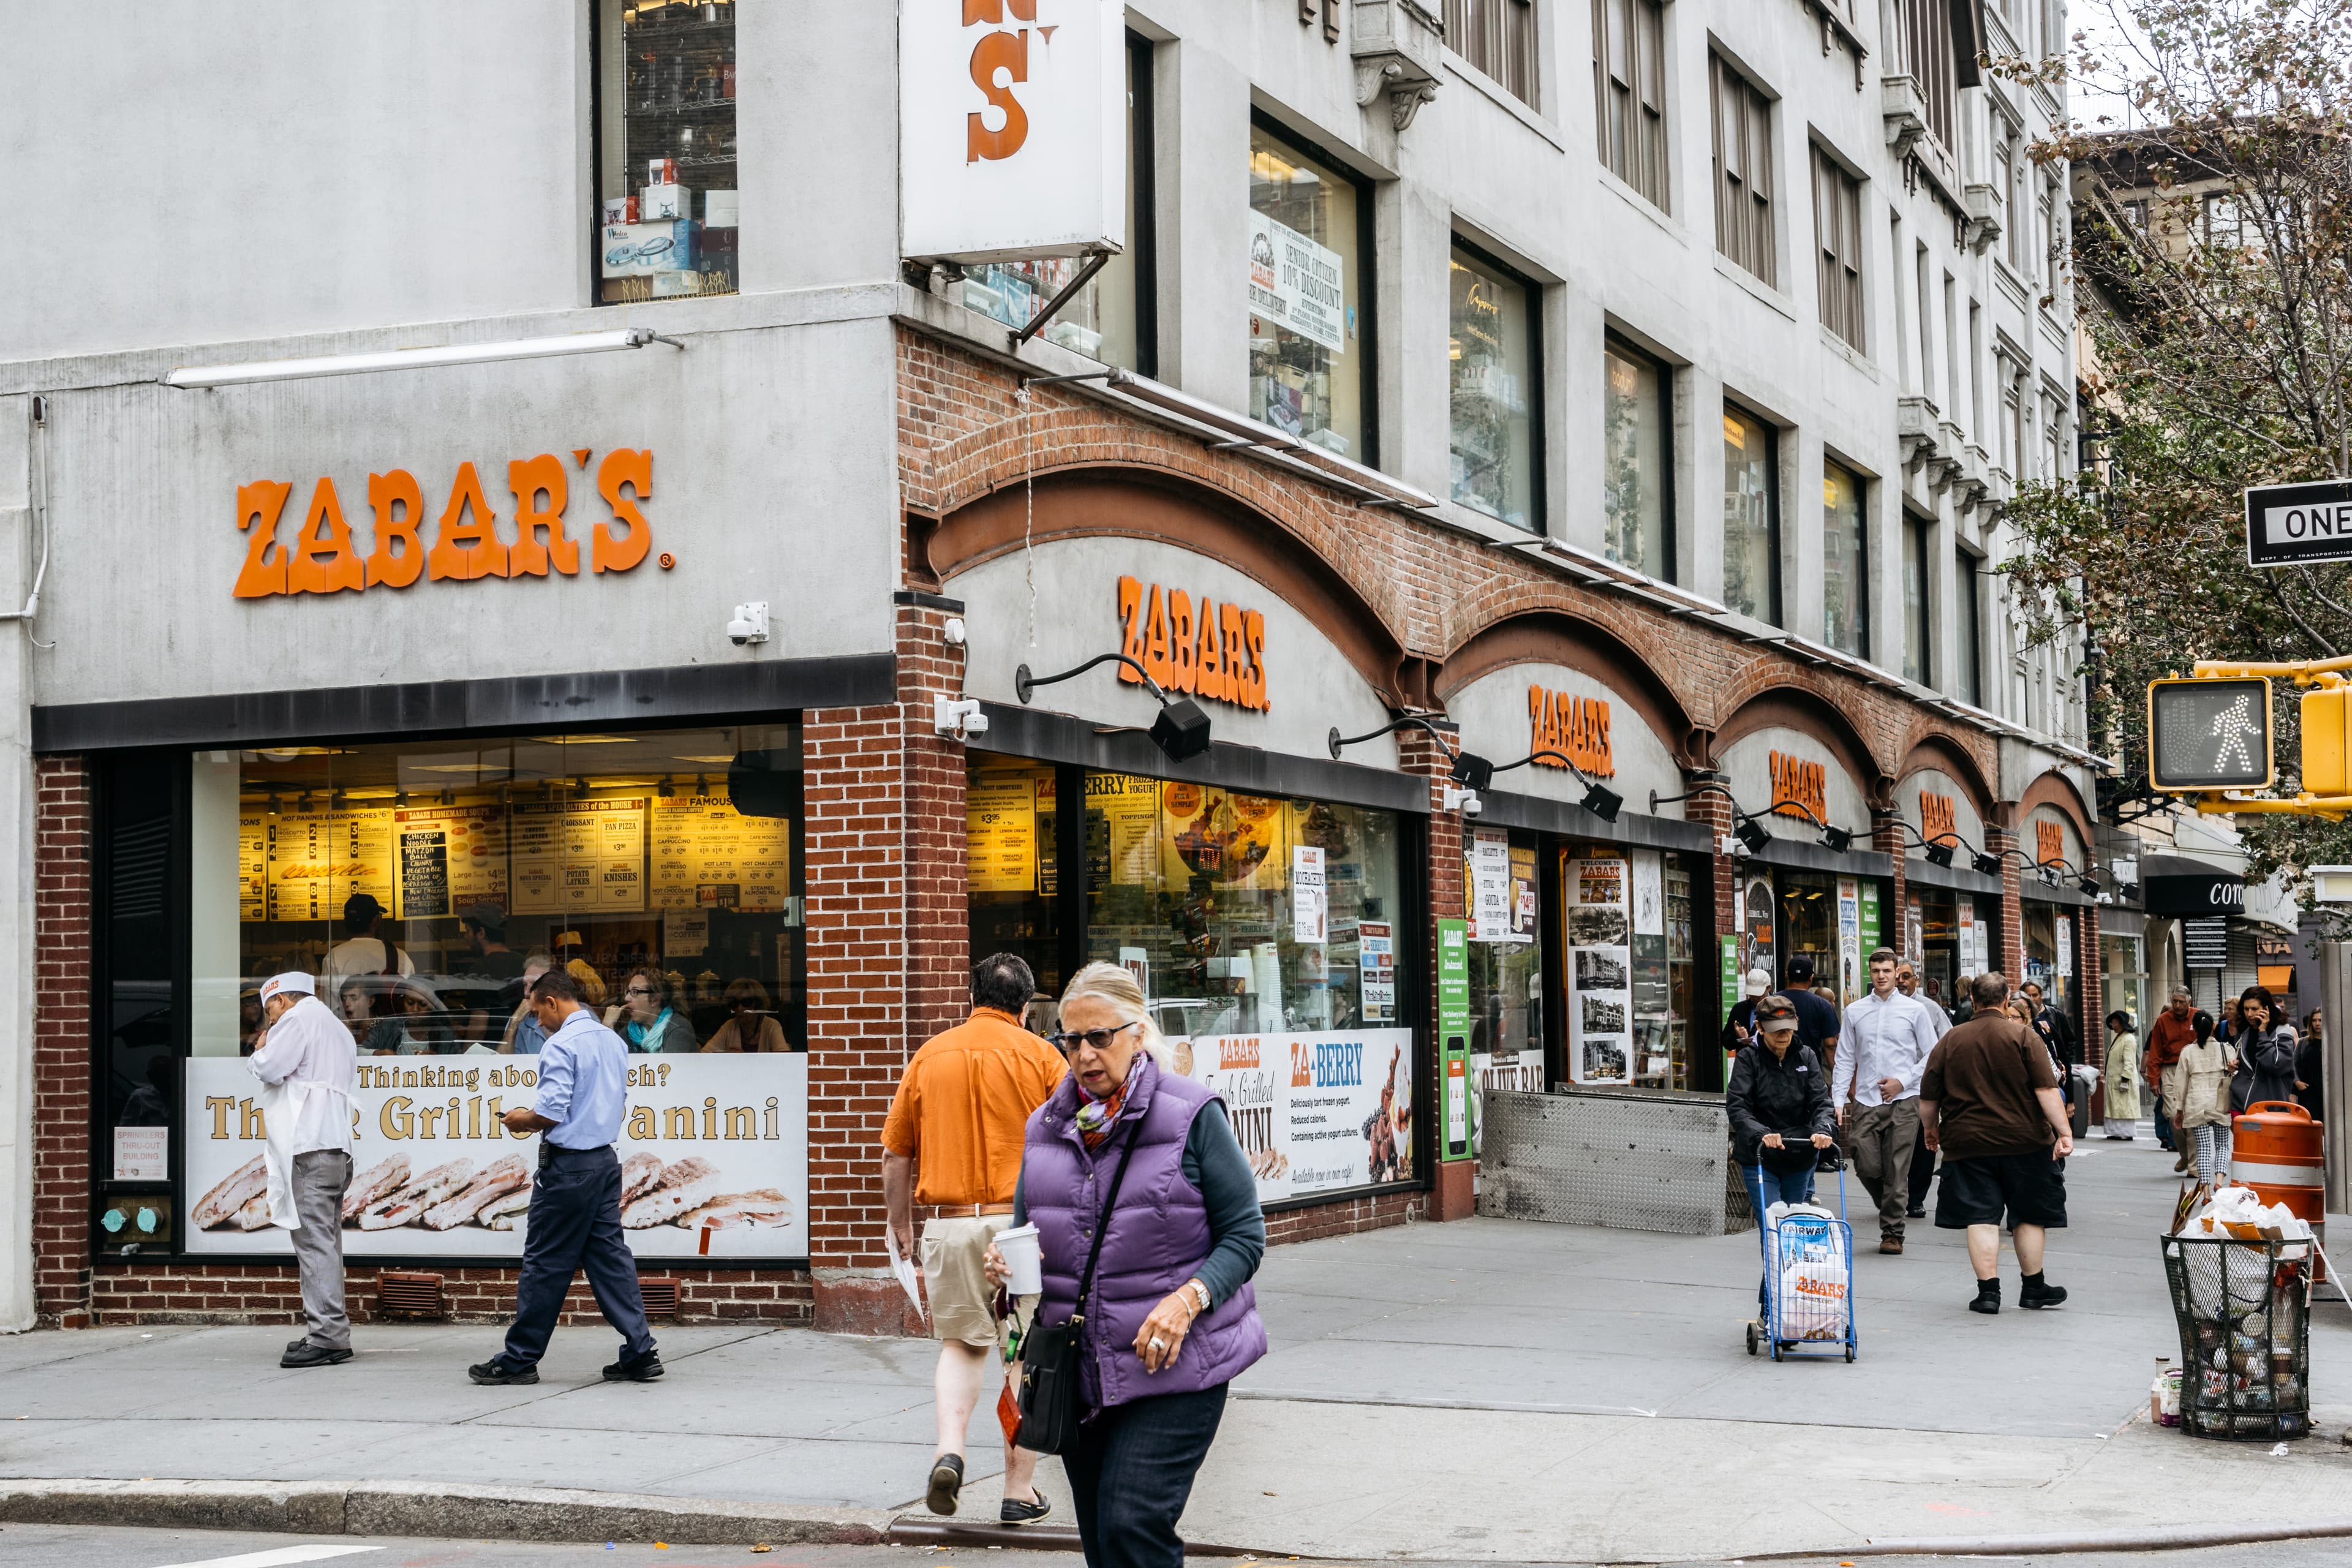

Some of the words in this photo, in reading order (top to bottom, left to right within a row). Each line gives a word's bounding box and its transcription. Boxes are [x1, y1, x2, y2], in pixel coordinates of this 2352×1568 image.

[1285, 244, 1310, 272] SENIOR
[1312, 257, 1338, 285] CITIZEN
[1283, 264, 1298, 290] 10%
[1301, 272, 1341, 310] DISCOUNT
[1257, 288, 1287, 315] DELIVERY
[1302, 298, 1327, 318] EVERYDAY
[1297, 309, 1311, 320] FLOOR
[1325, 329, 1341, 344] CENTER
[232, 447, 652, 598] ZABAR'S
[2285, 505, 2352, 538] ONE
[598, 801, 609, 810] the
[610, 800, 632, 809] HOUSE
[690, 797, 733, 806] FAMOUS
[432, 809, 468, 819] HOMEMADE
[469, 807, 489, 816] SOUPS
[310, 827, 315, 837] 2
[352, 824, 358, 835] 3
[309, 846, 315, 856] 5
[352, 845, 358, 854] 6
[406, 866, 442, 875] VEGETABLE
[603, 872, 638, 883] KNISHES
[1485, 894, 1499, 906] GOUDA
[1467, 924, 1477, 934] EW!
[357, 1065, 480, 1092] Thinking
[488, 1064, 538, 1087] abo
[626, 1063, 672, 1087] ch?
[1482, 1067, 1517, 1091] OLIVE
[1521, 1065, 1544, 1093] BAR
[1239, 1070, 1275, 1107] Grilled
[1291, 1097, 1313, 1109] Deliciously
[1314, 1098, 1322, 1107] tart
[1322, 1097, 1336, 1107] frozen
[1336, 1096, 1351, 1107] yogurt.
[622, 1096, 780, 1140] anini
[1291, 1116, 1310, 1125] Reduced
[1310, 1115, 1327, 1124] calories.
[1232, 1107, 1272, 1154] NINI
[1291, 1132, 1314, 1142] Containing
[1314, 1131, 1327, 1140] active
[1327, 1130, 1341, 1140] yogurt
[1341, 1128, 1359, 1137] cultures.
[1292, 1168, 1314, 1185] Available
[1315, 1172, 1325, 1181] now
[1325, 1170, 1332, 1180] in
[1782, 1225, 1826, 1235] FAIRWAY
